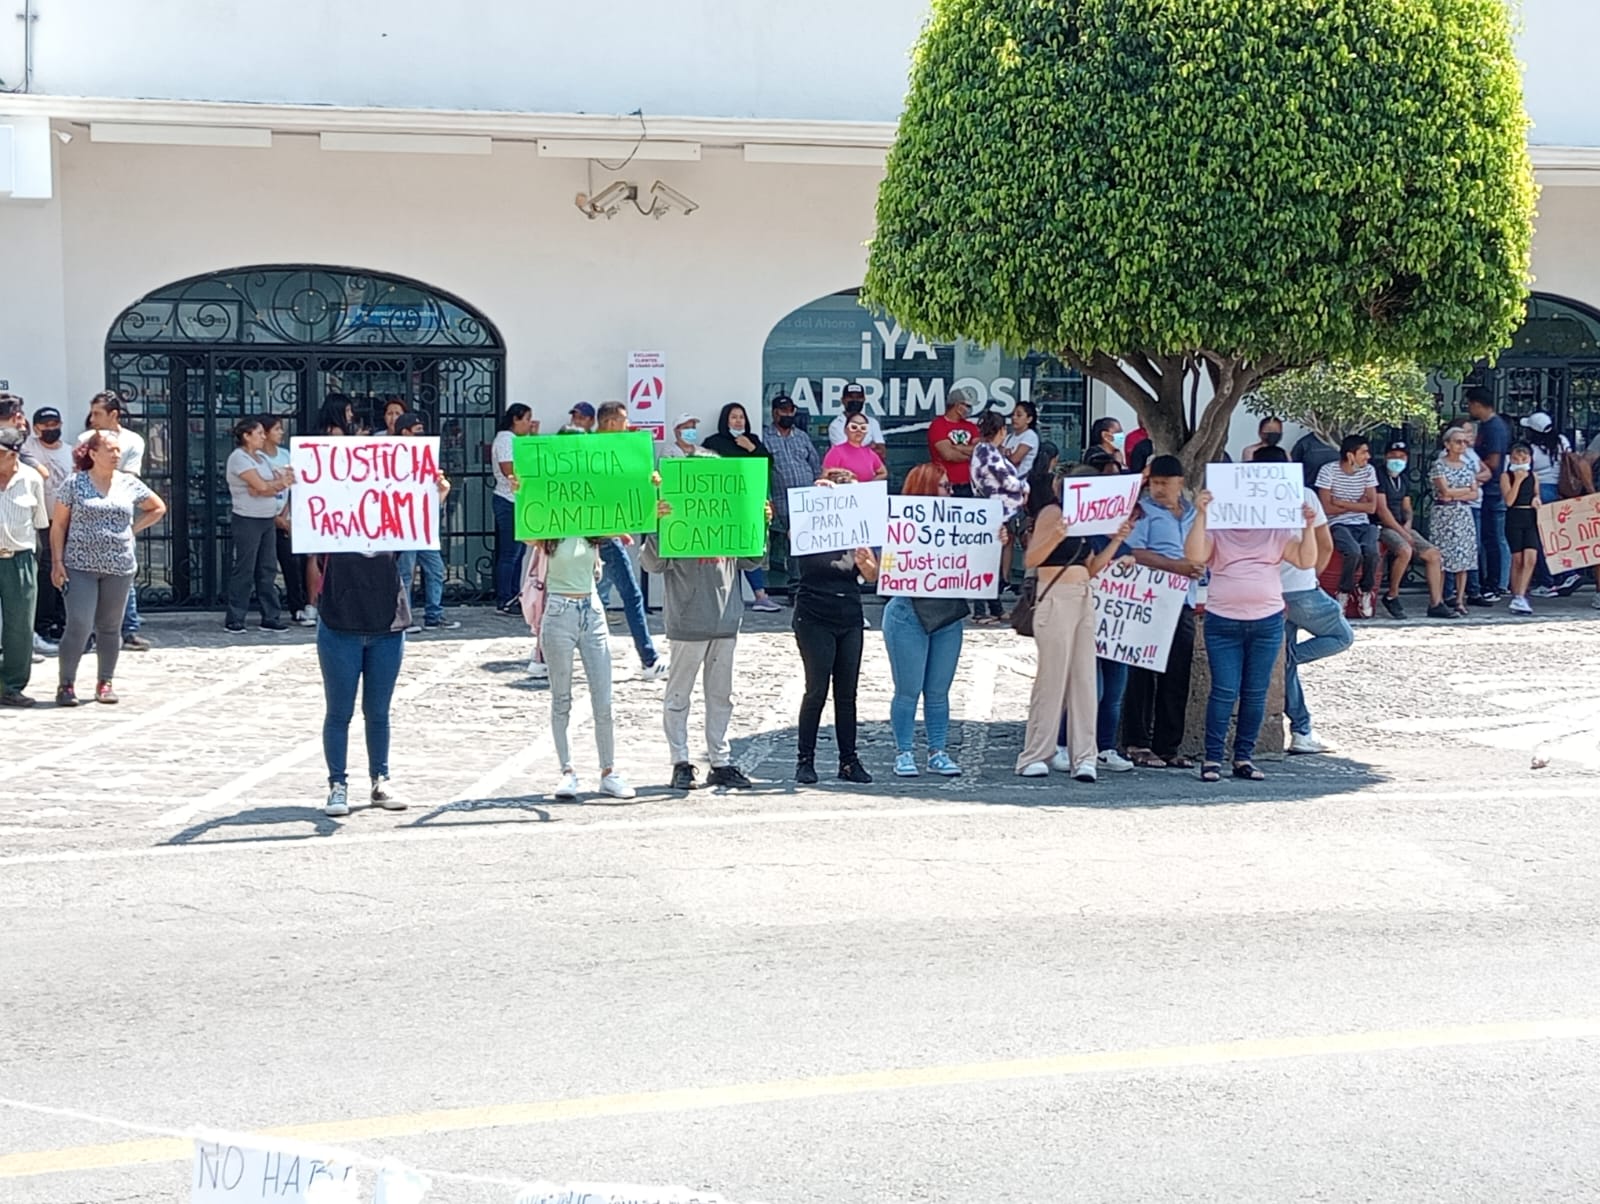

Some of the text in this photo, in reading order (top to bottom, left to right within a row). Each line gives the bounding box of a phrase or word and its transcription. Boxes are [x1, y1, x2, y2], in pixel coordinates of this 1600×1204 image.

[1234, 465, 1289, 490] TOCAN!
[546, 480, 596, 502] PARA
[1246, 481, 1300, 502] NO SE
[523, 487, 642, 534] CAMILA!!
[684, 498, 732, 519] PARA
[887, 496, 987, 526] Las Niñas
[811, 513, 844, 530] PARA
[887, 521, 916, 545] NO
[668, 519, 760, 552] CAMILA
[795, 519, 870, 552] CAMILA!!
[881, 569, 982, 592] Para Camila
[1100, 578, 1158, 605] AMILA
[1147, 568, 1165, 584] TU
[1167, 574, 1190, 592] VOZ
[1103, 599, 1153, 624] ESTAS
[198, 1143, 245, 1191] NO
